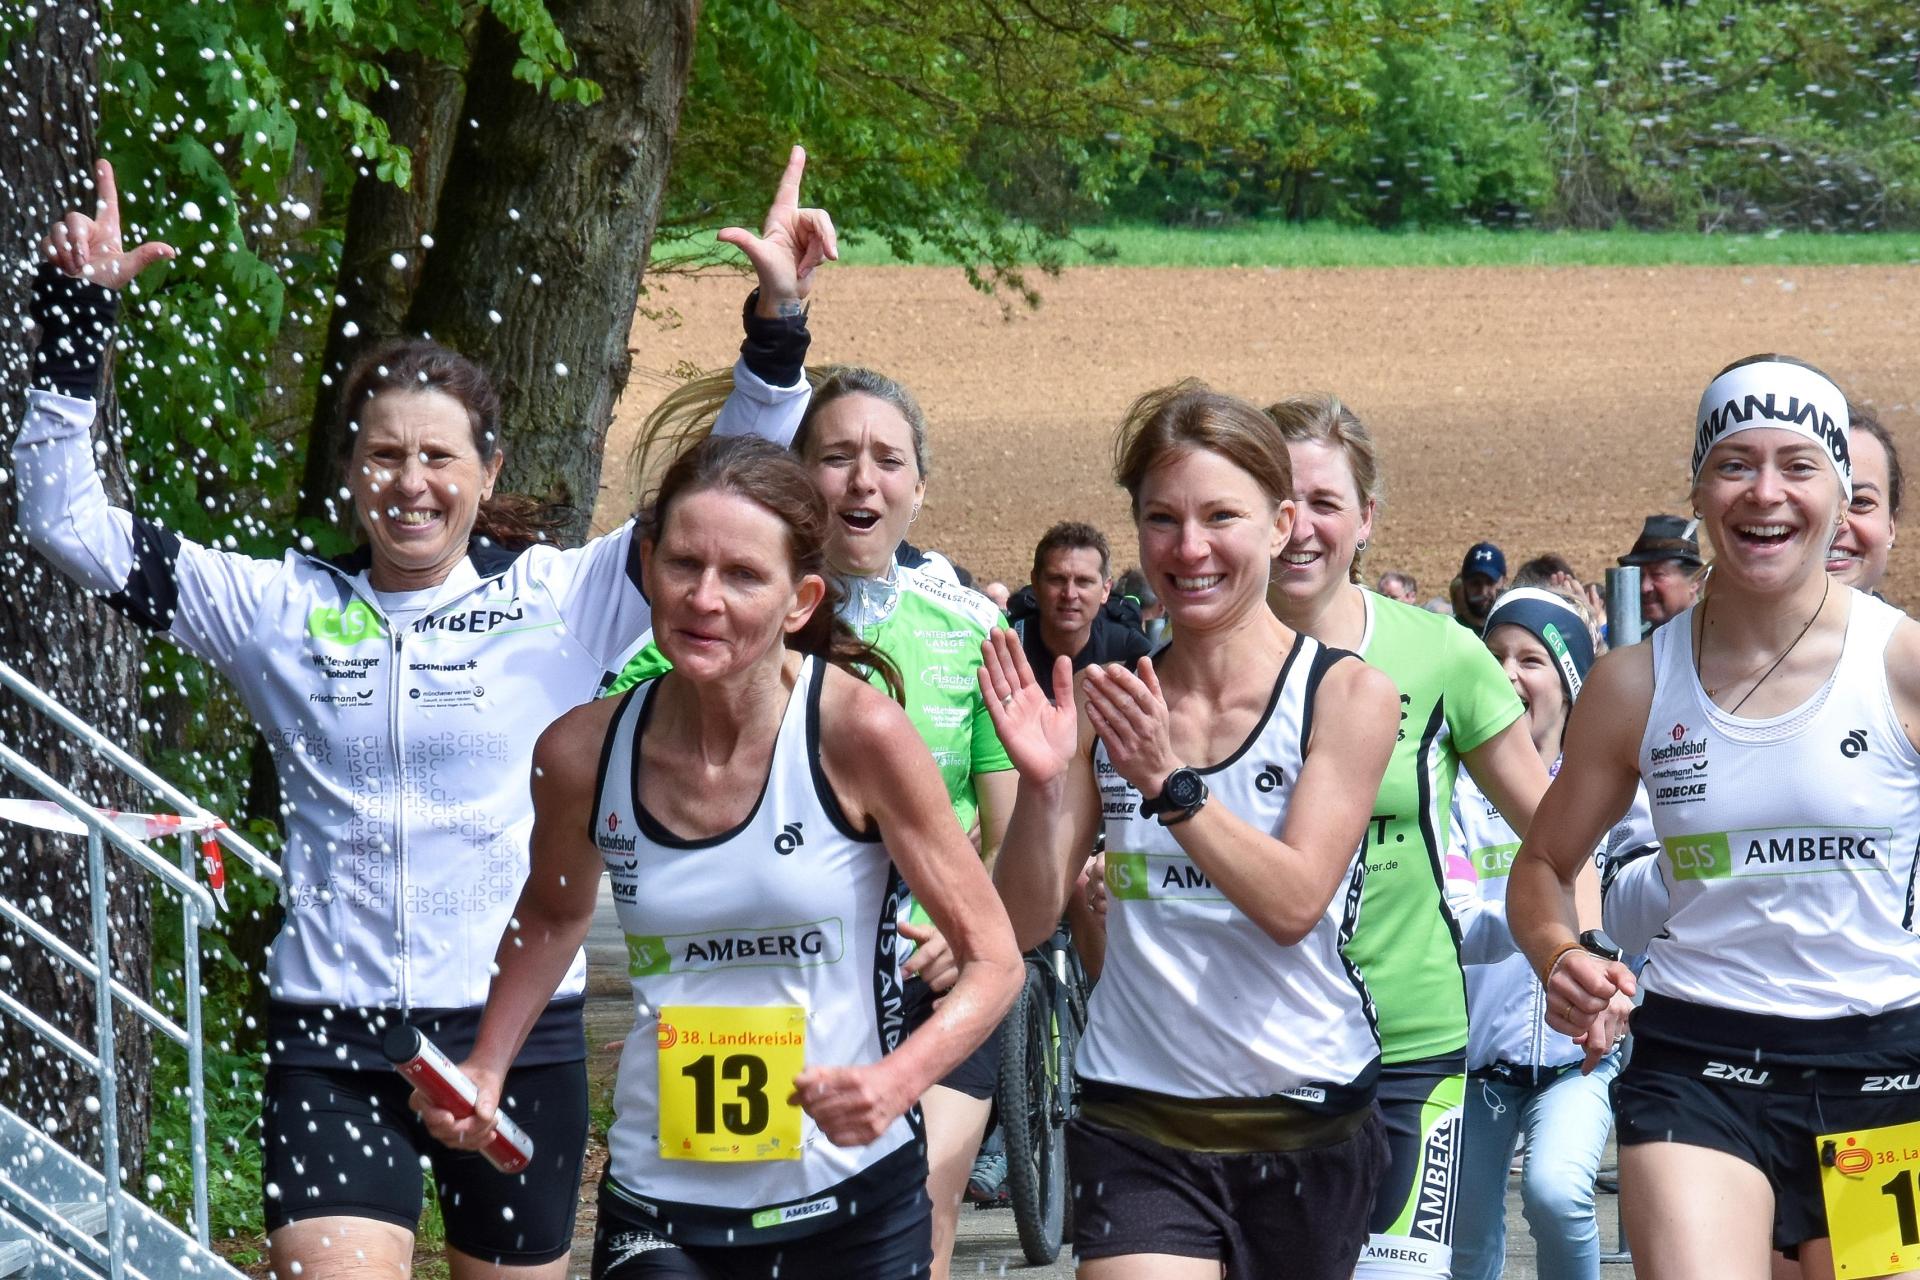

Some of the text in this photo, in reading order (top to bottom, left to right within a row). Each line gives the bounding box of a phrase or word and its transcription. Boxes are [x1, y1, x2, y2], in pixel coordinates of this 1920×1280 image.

[1548, 632, 1563, 652] CIS
[409, 663, 467, 672] SCHMINKE
[1563, 660, 1581, 695] AMBE
[1370, 814, 1405, 845] T.
[1481, 850, 1513, 872] CIS
[1674, 836, 1876, 870] CIS AMBERG
[1107, 863, 1132, 889] CIS
[1161, 864, 1212, 889] AM
[1365, 860, 1399, 875] yer.de
[880, 892, 898, 957] CIS
[684, 931, 823, 963] AMBERG
[681, 1030, 805, 1047] 38. Landkreisla
[1702, 1061, 1769, 1085] 2XU
[1860, 1074, 1920, 1092] 2XU
[682, 1053, 770, 1136] 13
[1876, 1148, 1920, 1165] 38. La
[783, 1201, 832, 1220] AMBERG
[1881, 1169, 1920, 1247] 1
[1366, 1247, 1429, 1264] AMBERG
